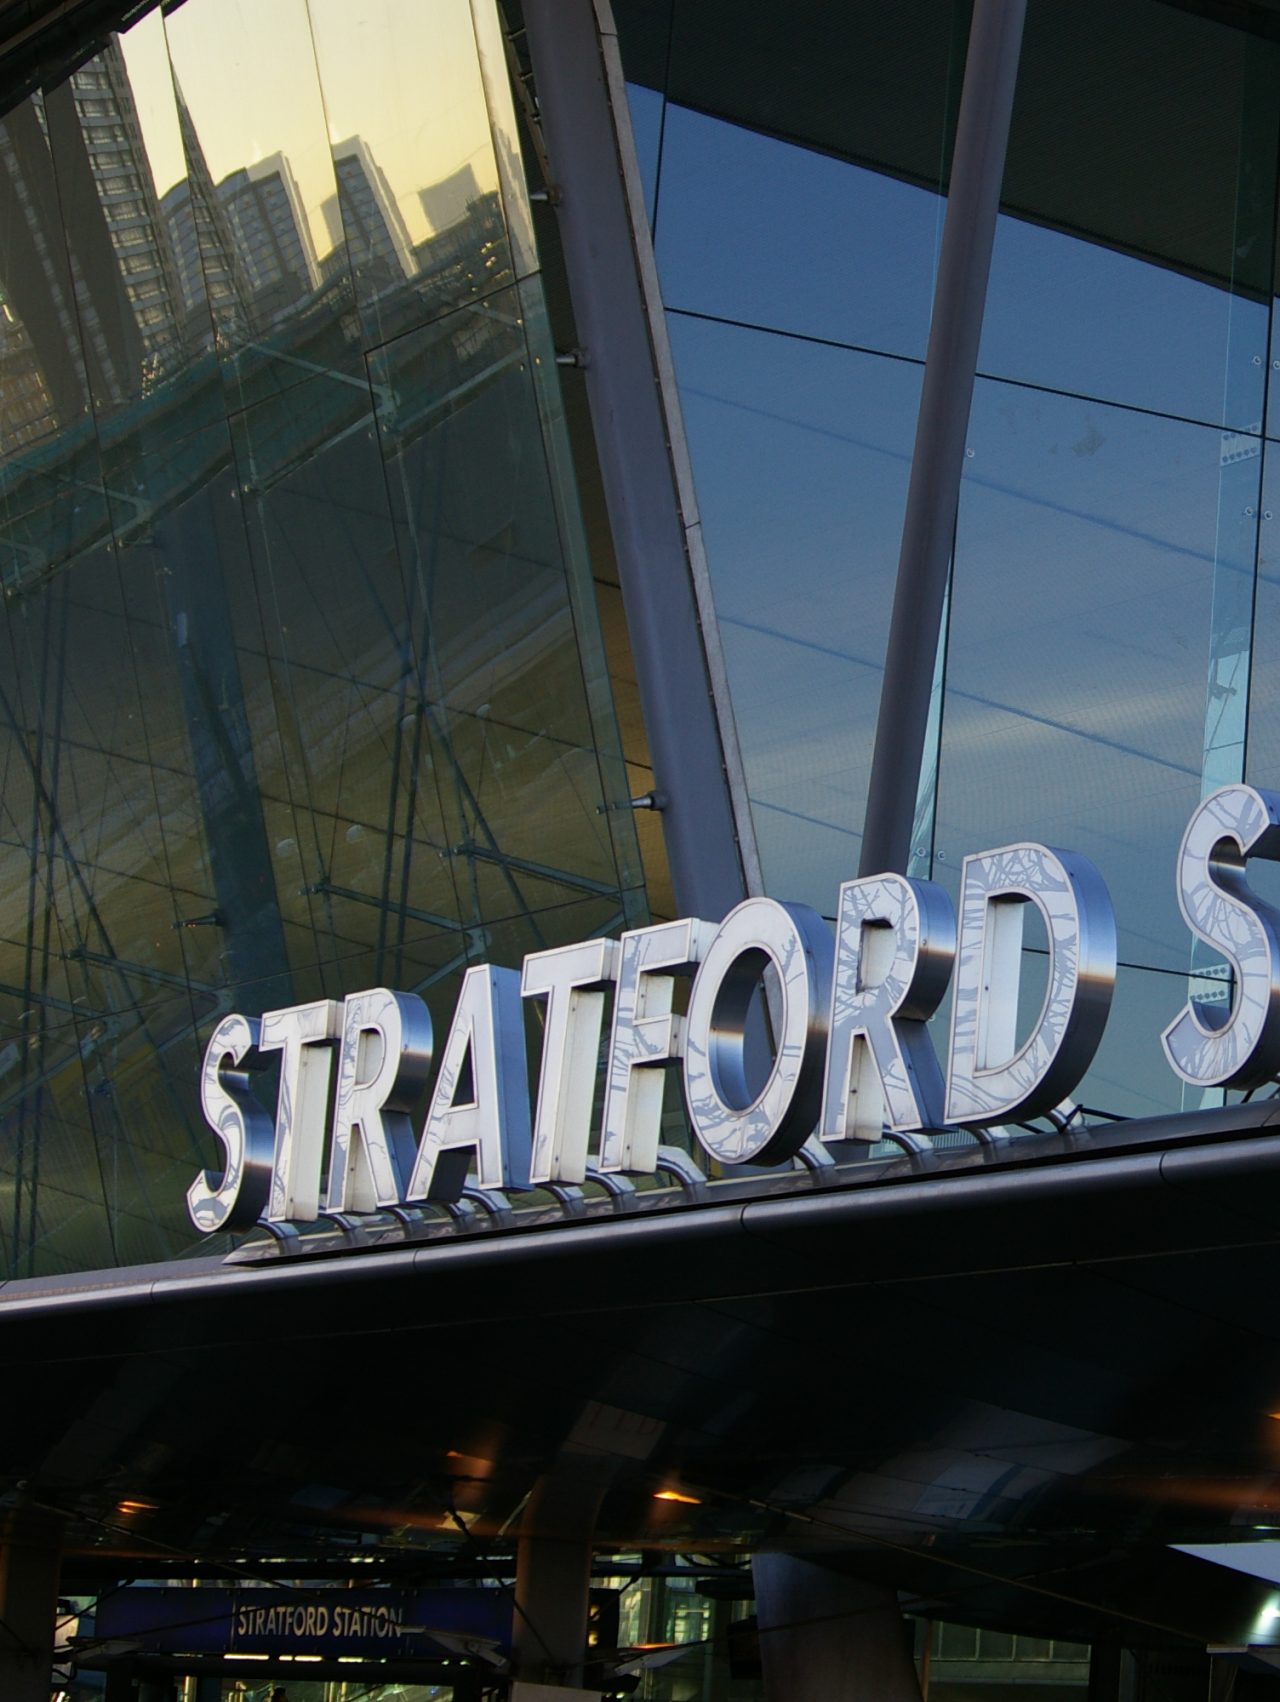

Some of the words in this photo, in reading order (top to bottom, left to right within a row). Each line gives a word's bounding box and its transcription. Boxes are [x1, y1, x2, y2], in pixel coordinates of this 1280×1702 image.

[187, 842, 1116, 1233] STRATFORD
[237, 1605, 329, 1636] STRATFORD
[332, 1605, 403, 1638] STATION
